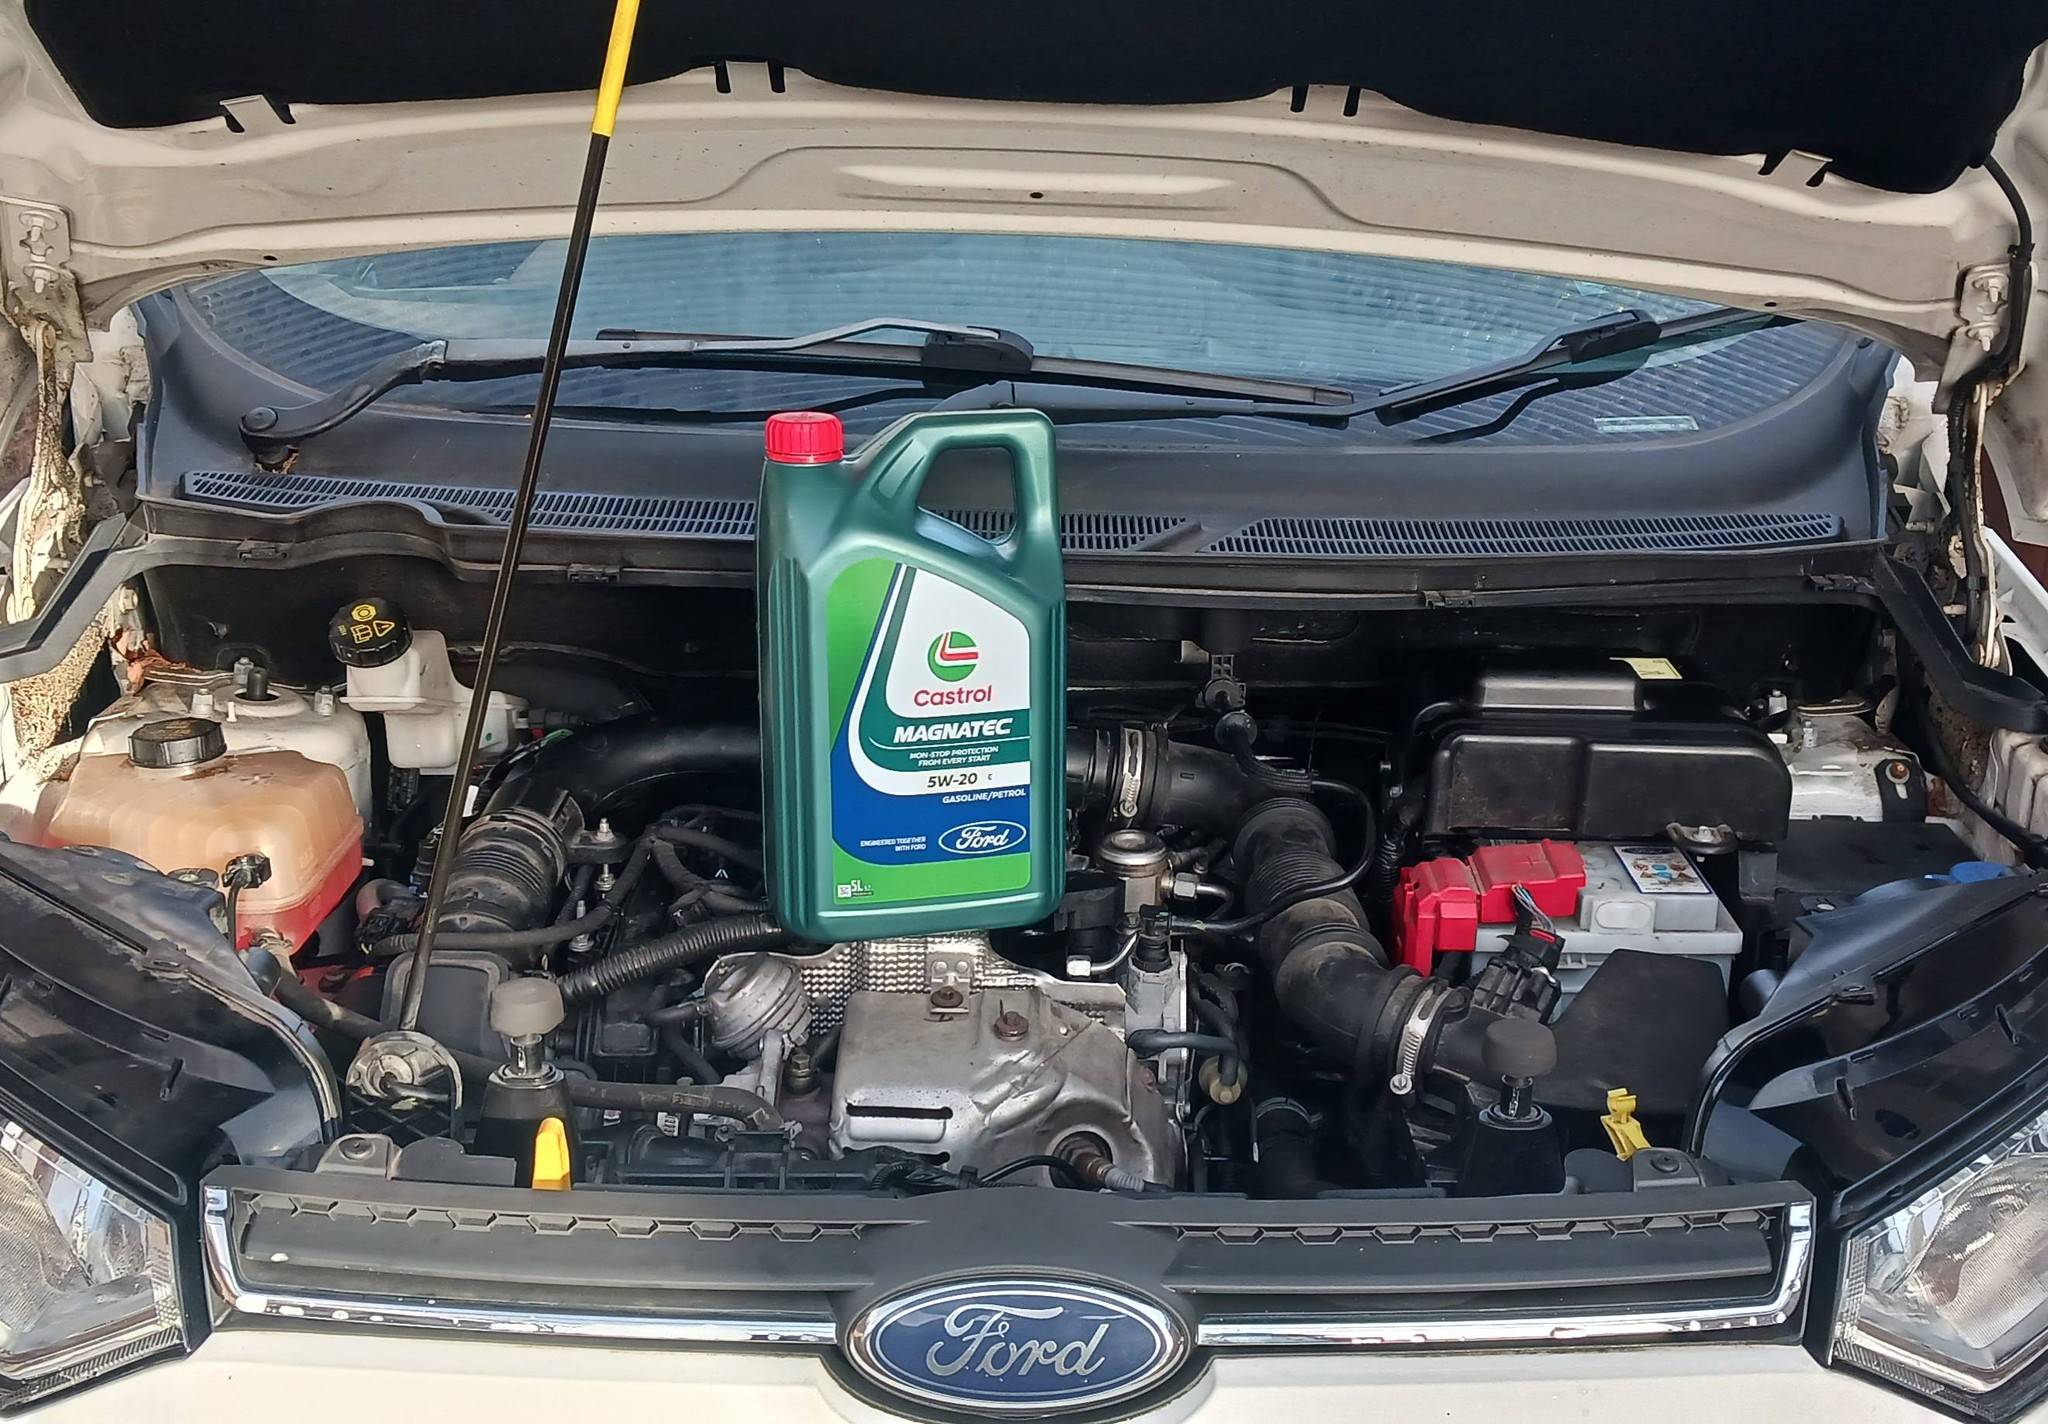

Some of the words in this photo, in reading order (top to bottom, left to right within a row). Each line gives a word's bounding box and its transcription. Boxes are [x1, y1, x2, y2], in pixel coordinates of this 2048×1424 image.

[913, 684, 993, 707] Castrol
[893, 718, 1013, 743] MAGNATEC
[909, 751, 951, 760] NON-STOP
[951, 746, 999, 756] PROTECTION
[918, 759, 941, 767] FROM
[942, 756, 967, 764] EVERY
[967, 754, 991, 763] START
[927, 772, 978, 788] 5W-20
[942, 789, 1026, 803] GASOLINE/PETROL
[955, 825, 1010, 850] Ford
[910, 843, 927, 851] FORD
[851, 879, 864, 892] 5L
[926, 1303, 1109, 1377] Ford
